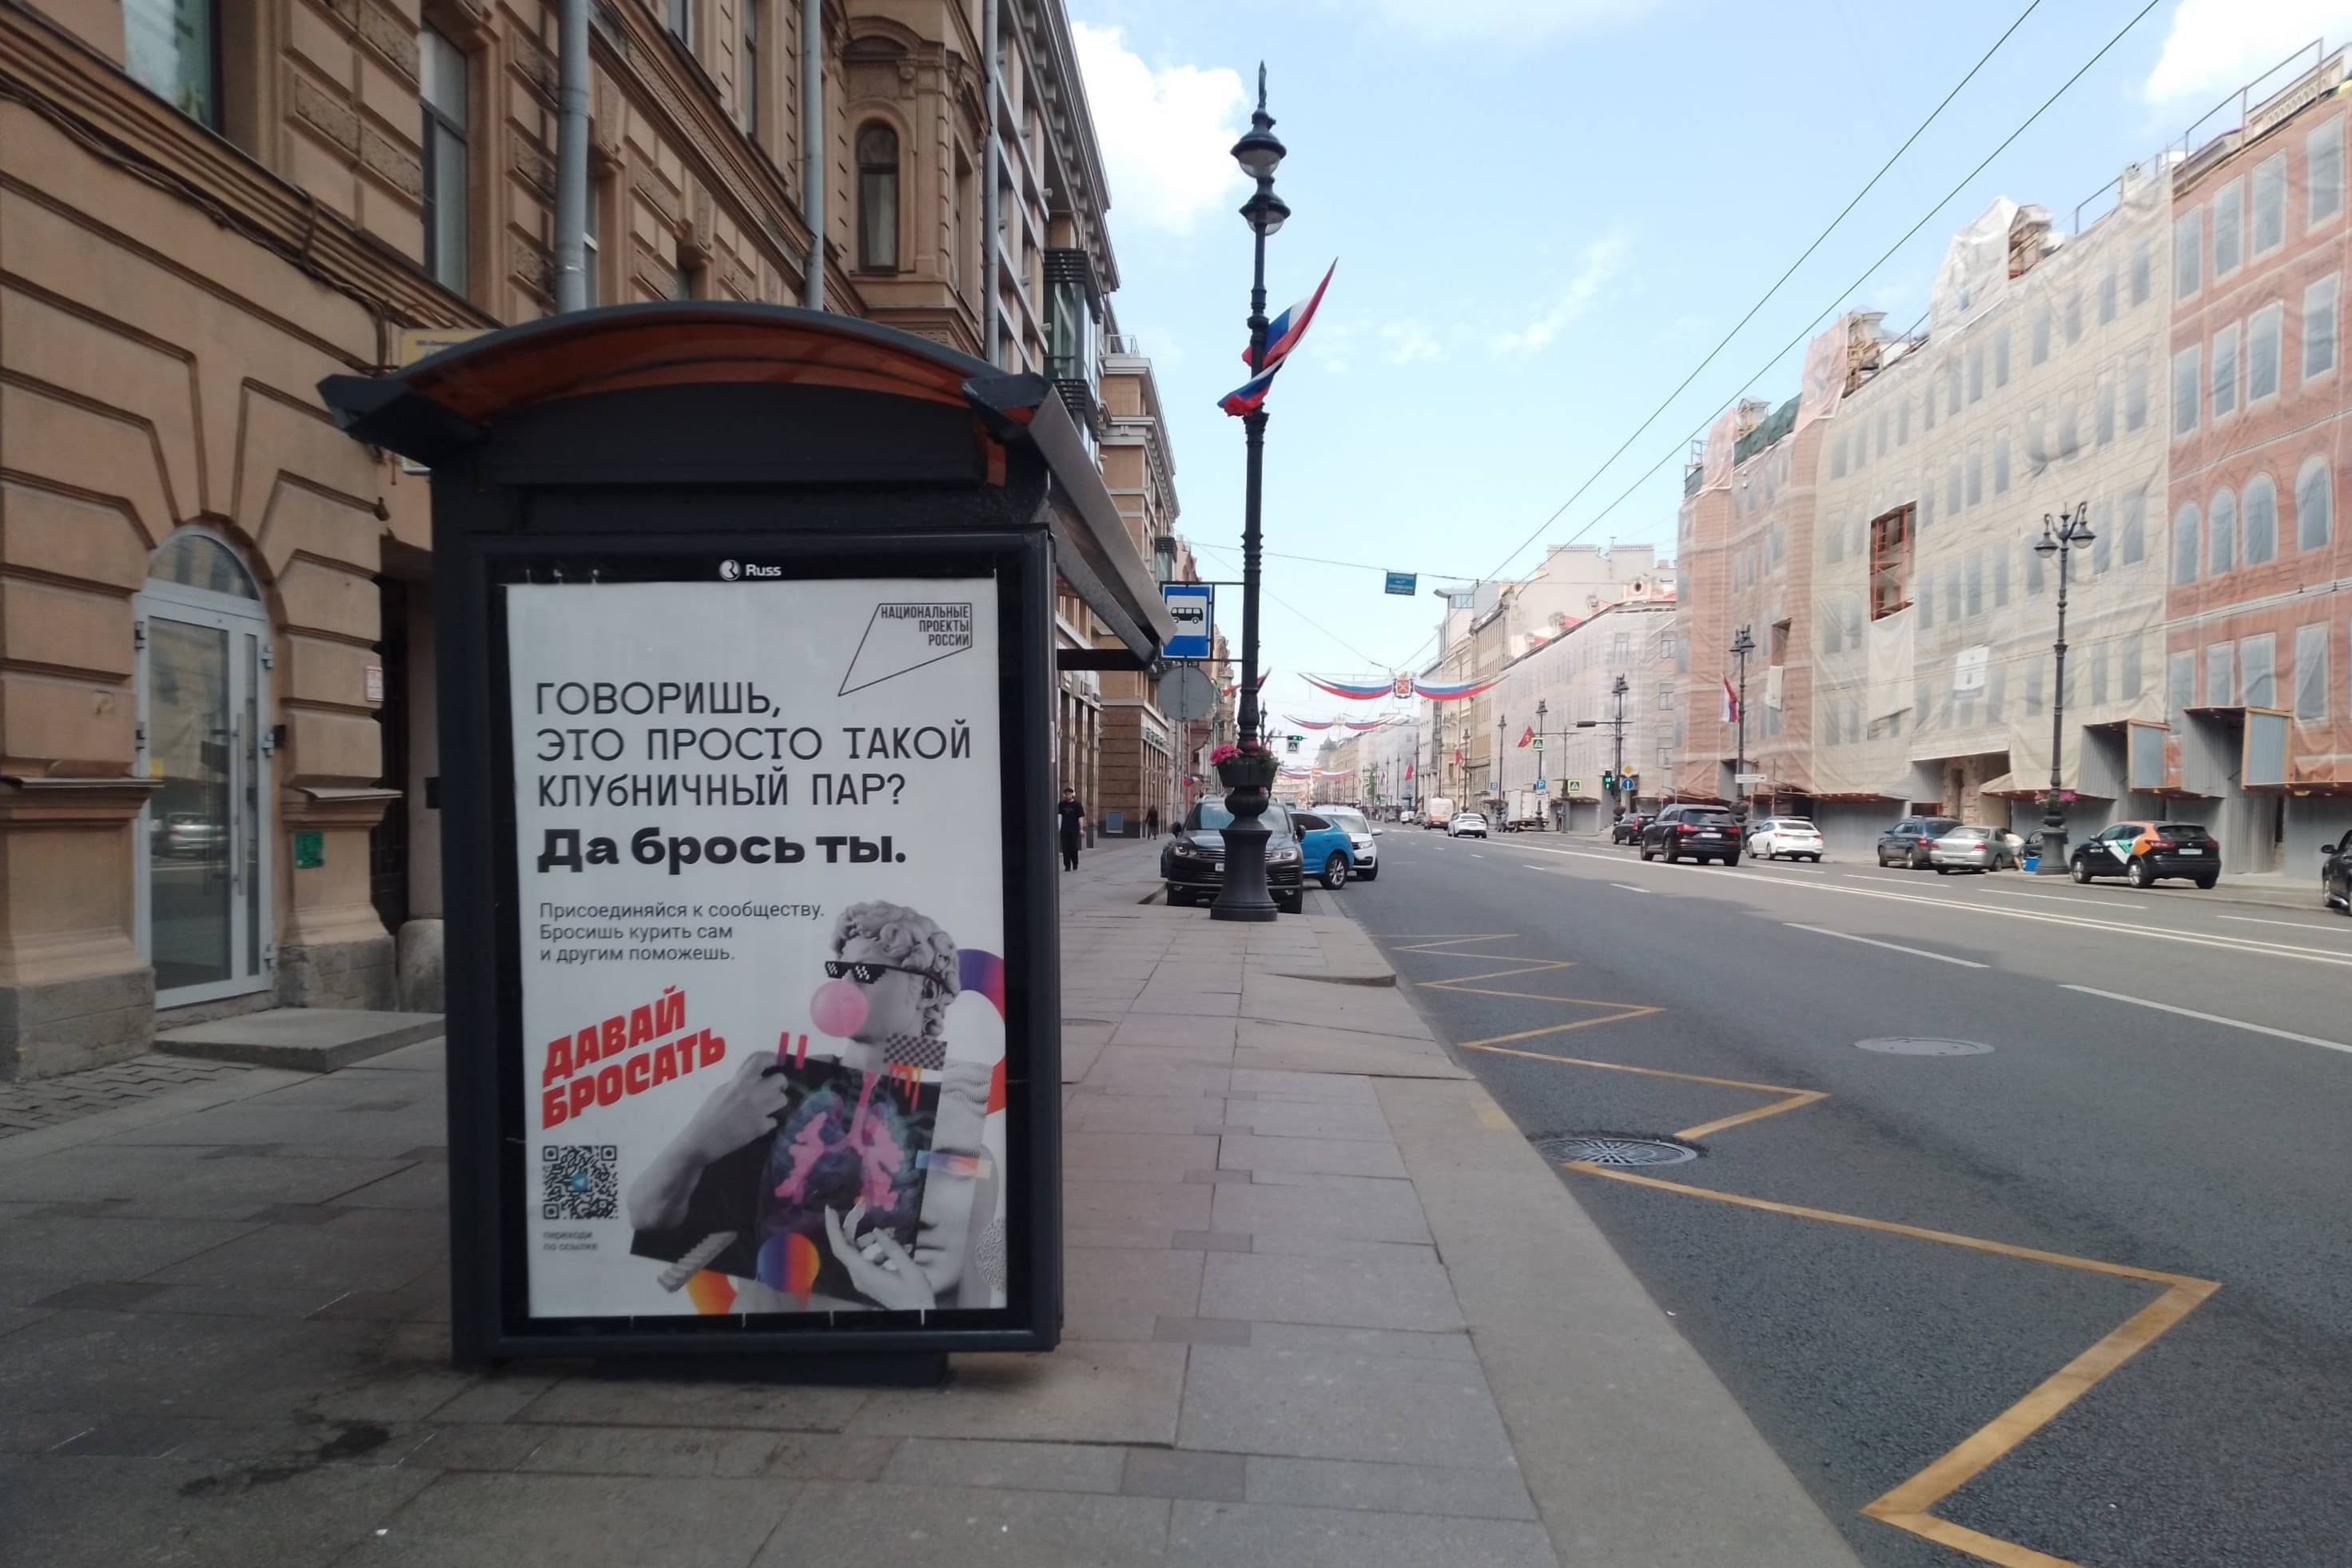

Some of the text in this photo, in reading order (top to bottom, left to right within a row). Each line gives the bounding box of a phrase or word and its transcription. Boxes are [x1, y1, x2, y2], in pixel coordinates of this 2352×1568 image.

[745, 563, 782, 577] Russ
[881, 606, 969, 619] НАЦИОНАЛЬНЫЕ
[919, 619, 969, 632] ПРОЕКТЫ
[928, 634, 969, 647] РОССИИ
[536, 681, 781, 718] ГОВОРИШЬ,
[536, 718, 970, 762] ЭТО ПРОСТО ТАКОЙ
[812, 773, 905, 806] ПАР?
[536, 826, 906, 876] Да брось ты.
[539, 900, 825, 921] Присоединяйся к сообществу.
[539, 923, 733, 944] Бросишь курить сам
[540, 947, 734, 965] и другим поможешь.
[543, 985, 685, 1087] ДАВАЙ
[543, 1029, 726, 1129] БРОСАТЬ
